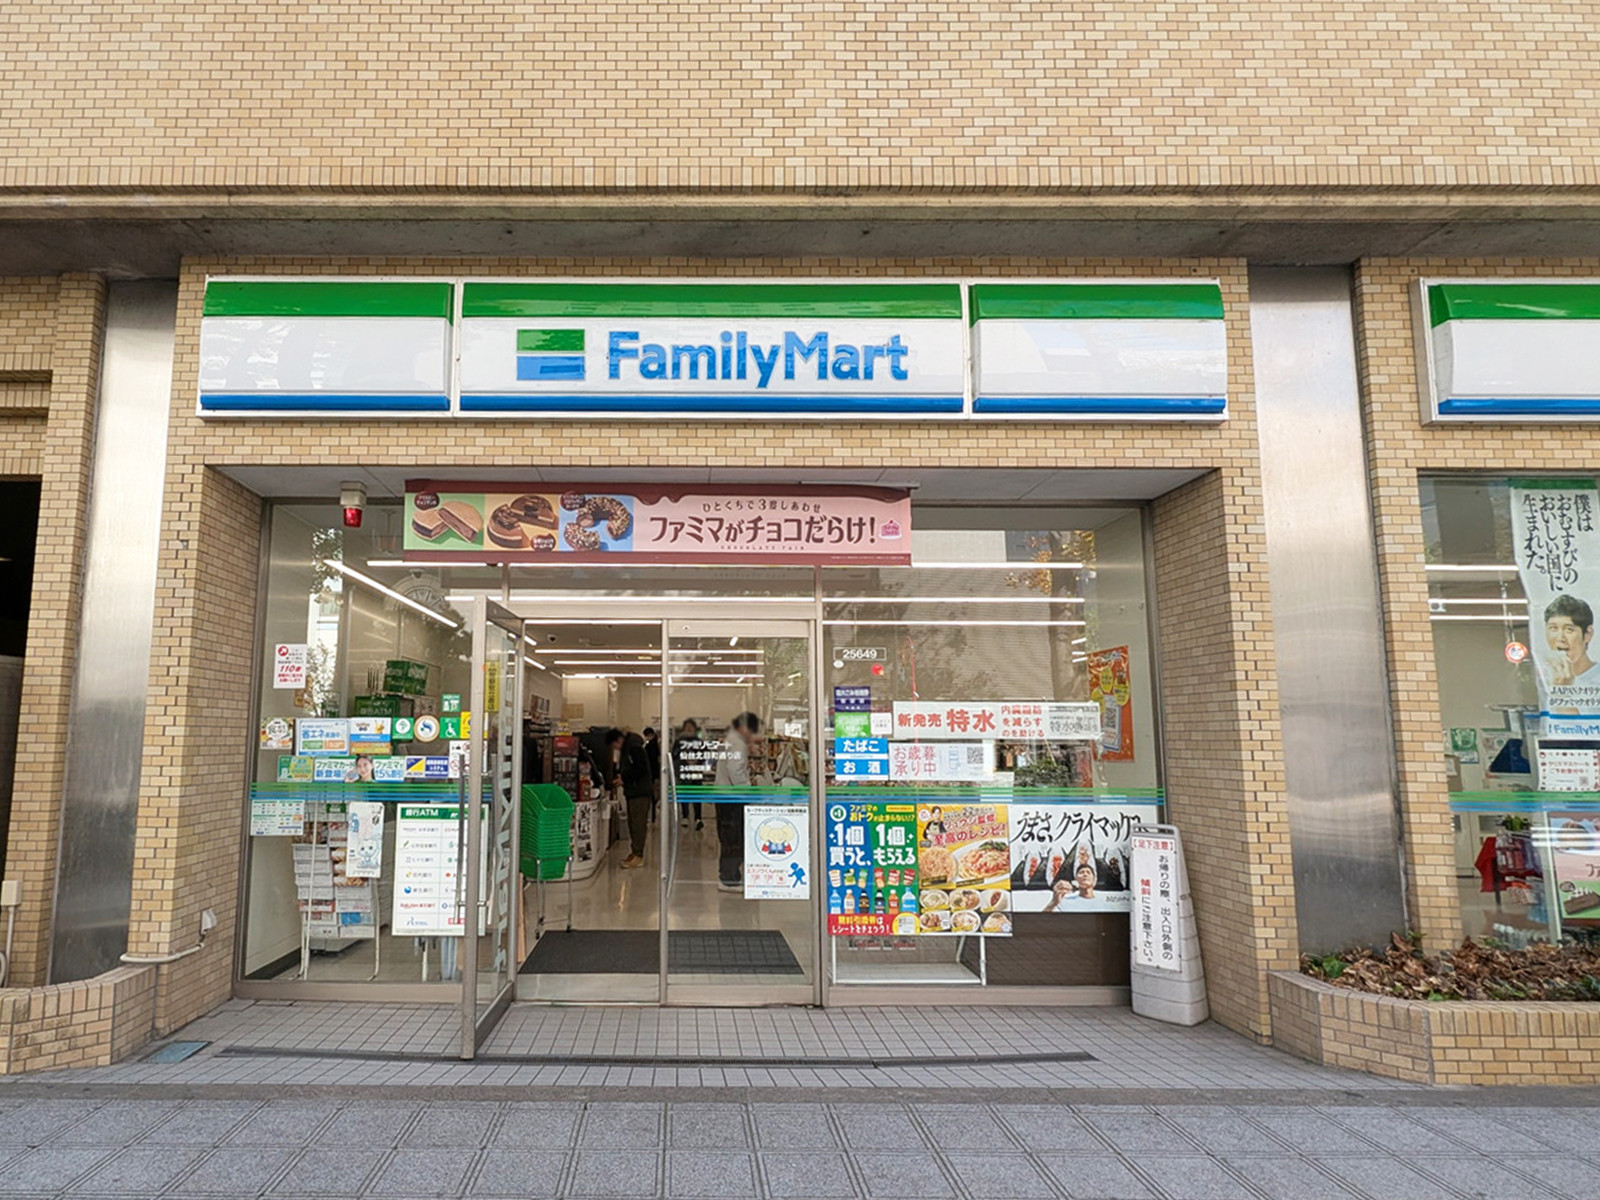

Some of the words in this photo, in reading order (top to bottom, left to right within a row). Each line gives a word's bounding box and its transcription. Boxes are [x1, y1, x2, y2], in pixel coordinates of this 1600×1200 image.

[608, 331, 908, 388] FamilyMart
[1574, 494, 1594, 532] 僕は
[649, 515, 875, 544] ファミマがチョコだらけ!
[1522, 494, 1547, 574] 生まれた。
[1557, 494, 1578, 585] おむすびの
[1539, 494, 1563, 591] おいしい国に
[843, 649, 878, 659] 25649
[898, 713, 942, 728] 新発売
[946, 708, 996, 733] 特水
[1002, 717, 1042, 727] を減らす
[1554, 724, 1600, 735] FamilyM
[1002, 729, 1045, 738] のを助ける
[843, 739, 880, 752] たばこ
[894, 745, 936, 761] お歳暮
[843, 760, 881, 774] お酒
[894, 761, 936, 777] 承り中
[834, 823, 864, 846] 1個
[875, 823, 905, 847] 1個
[829, 846, 872, 867] 買うと、
[873, 847, 916, 866] もらえる
